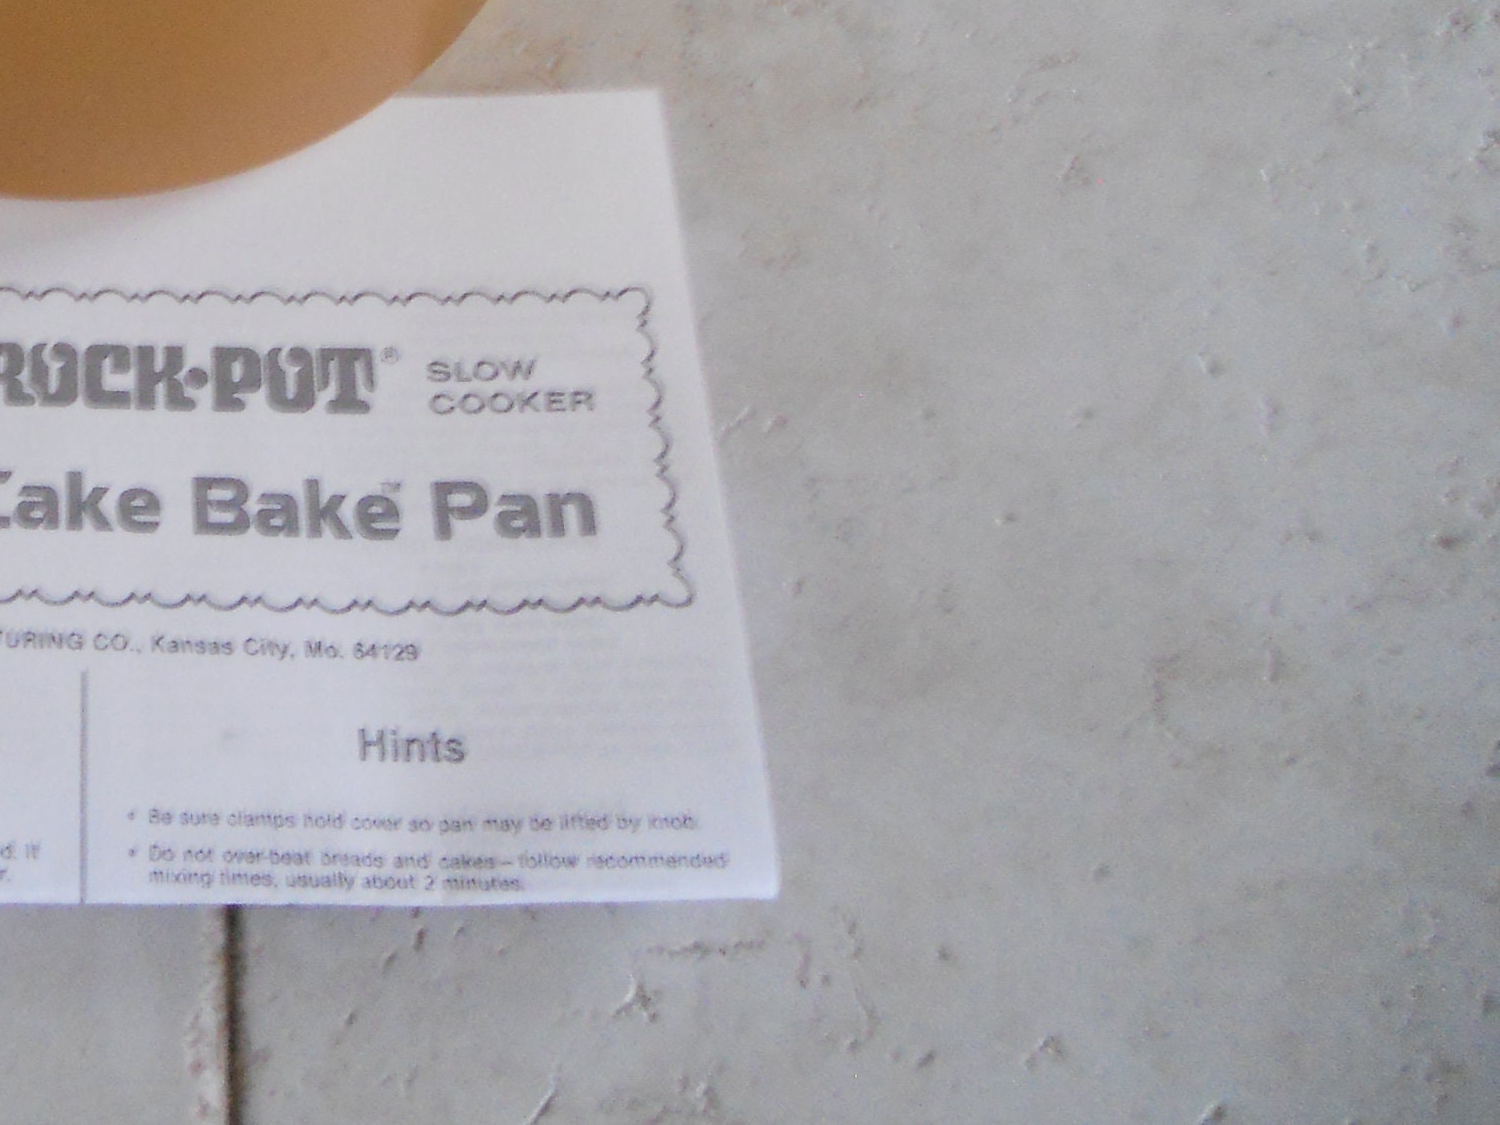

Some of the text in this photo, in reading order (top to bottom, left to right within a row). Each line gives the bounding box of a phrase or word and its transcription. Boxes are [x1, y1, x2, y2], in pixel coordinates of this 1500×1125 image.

[426, 358, 538, 383] SLOW
[429, 391, 596, 415] COOKER
[430, 480, 597, 541] Pan
[150, 633, 234, 656] Kansas
[303, 639, 345, 660] Mo.
[351, 641, 420, 662] 64129
[357, 727, 466, 764] Hints
[149, 809, 173, 825] Be
[178, 811, 220, 826] sure
[226, 811, 296, 830] clamps
[303, 812, 344, 830] hold
[352, 817, 404, 832] cover
[408, 818, 431, 833] so
[438, 817, 473, 836] pan
[481, 817, 522, 836] may
[529, 815, 553, 832] be
[558, 813, 609, 831] lifted
[615, 813, 642, 834] by
[150, 844, 174, 862] Do
[182, 846, 214, 863] not
[320, 849, 384, 869] breads
[393, 849, 430, 870] and
[517, 850, 579, 869] follow
[586, 851, 729, 870] recommended
[149, 868, 212, 889] mixing
[286, 871, 354, 891] usually
[361, 873, 416, 890] about
[424, 875, 435, 891] 2
